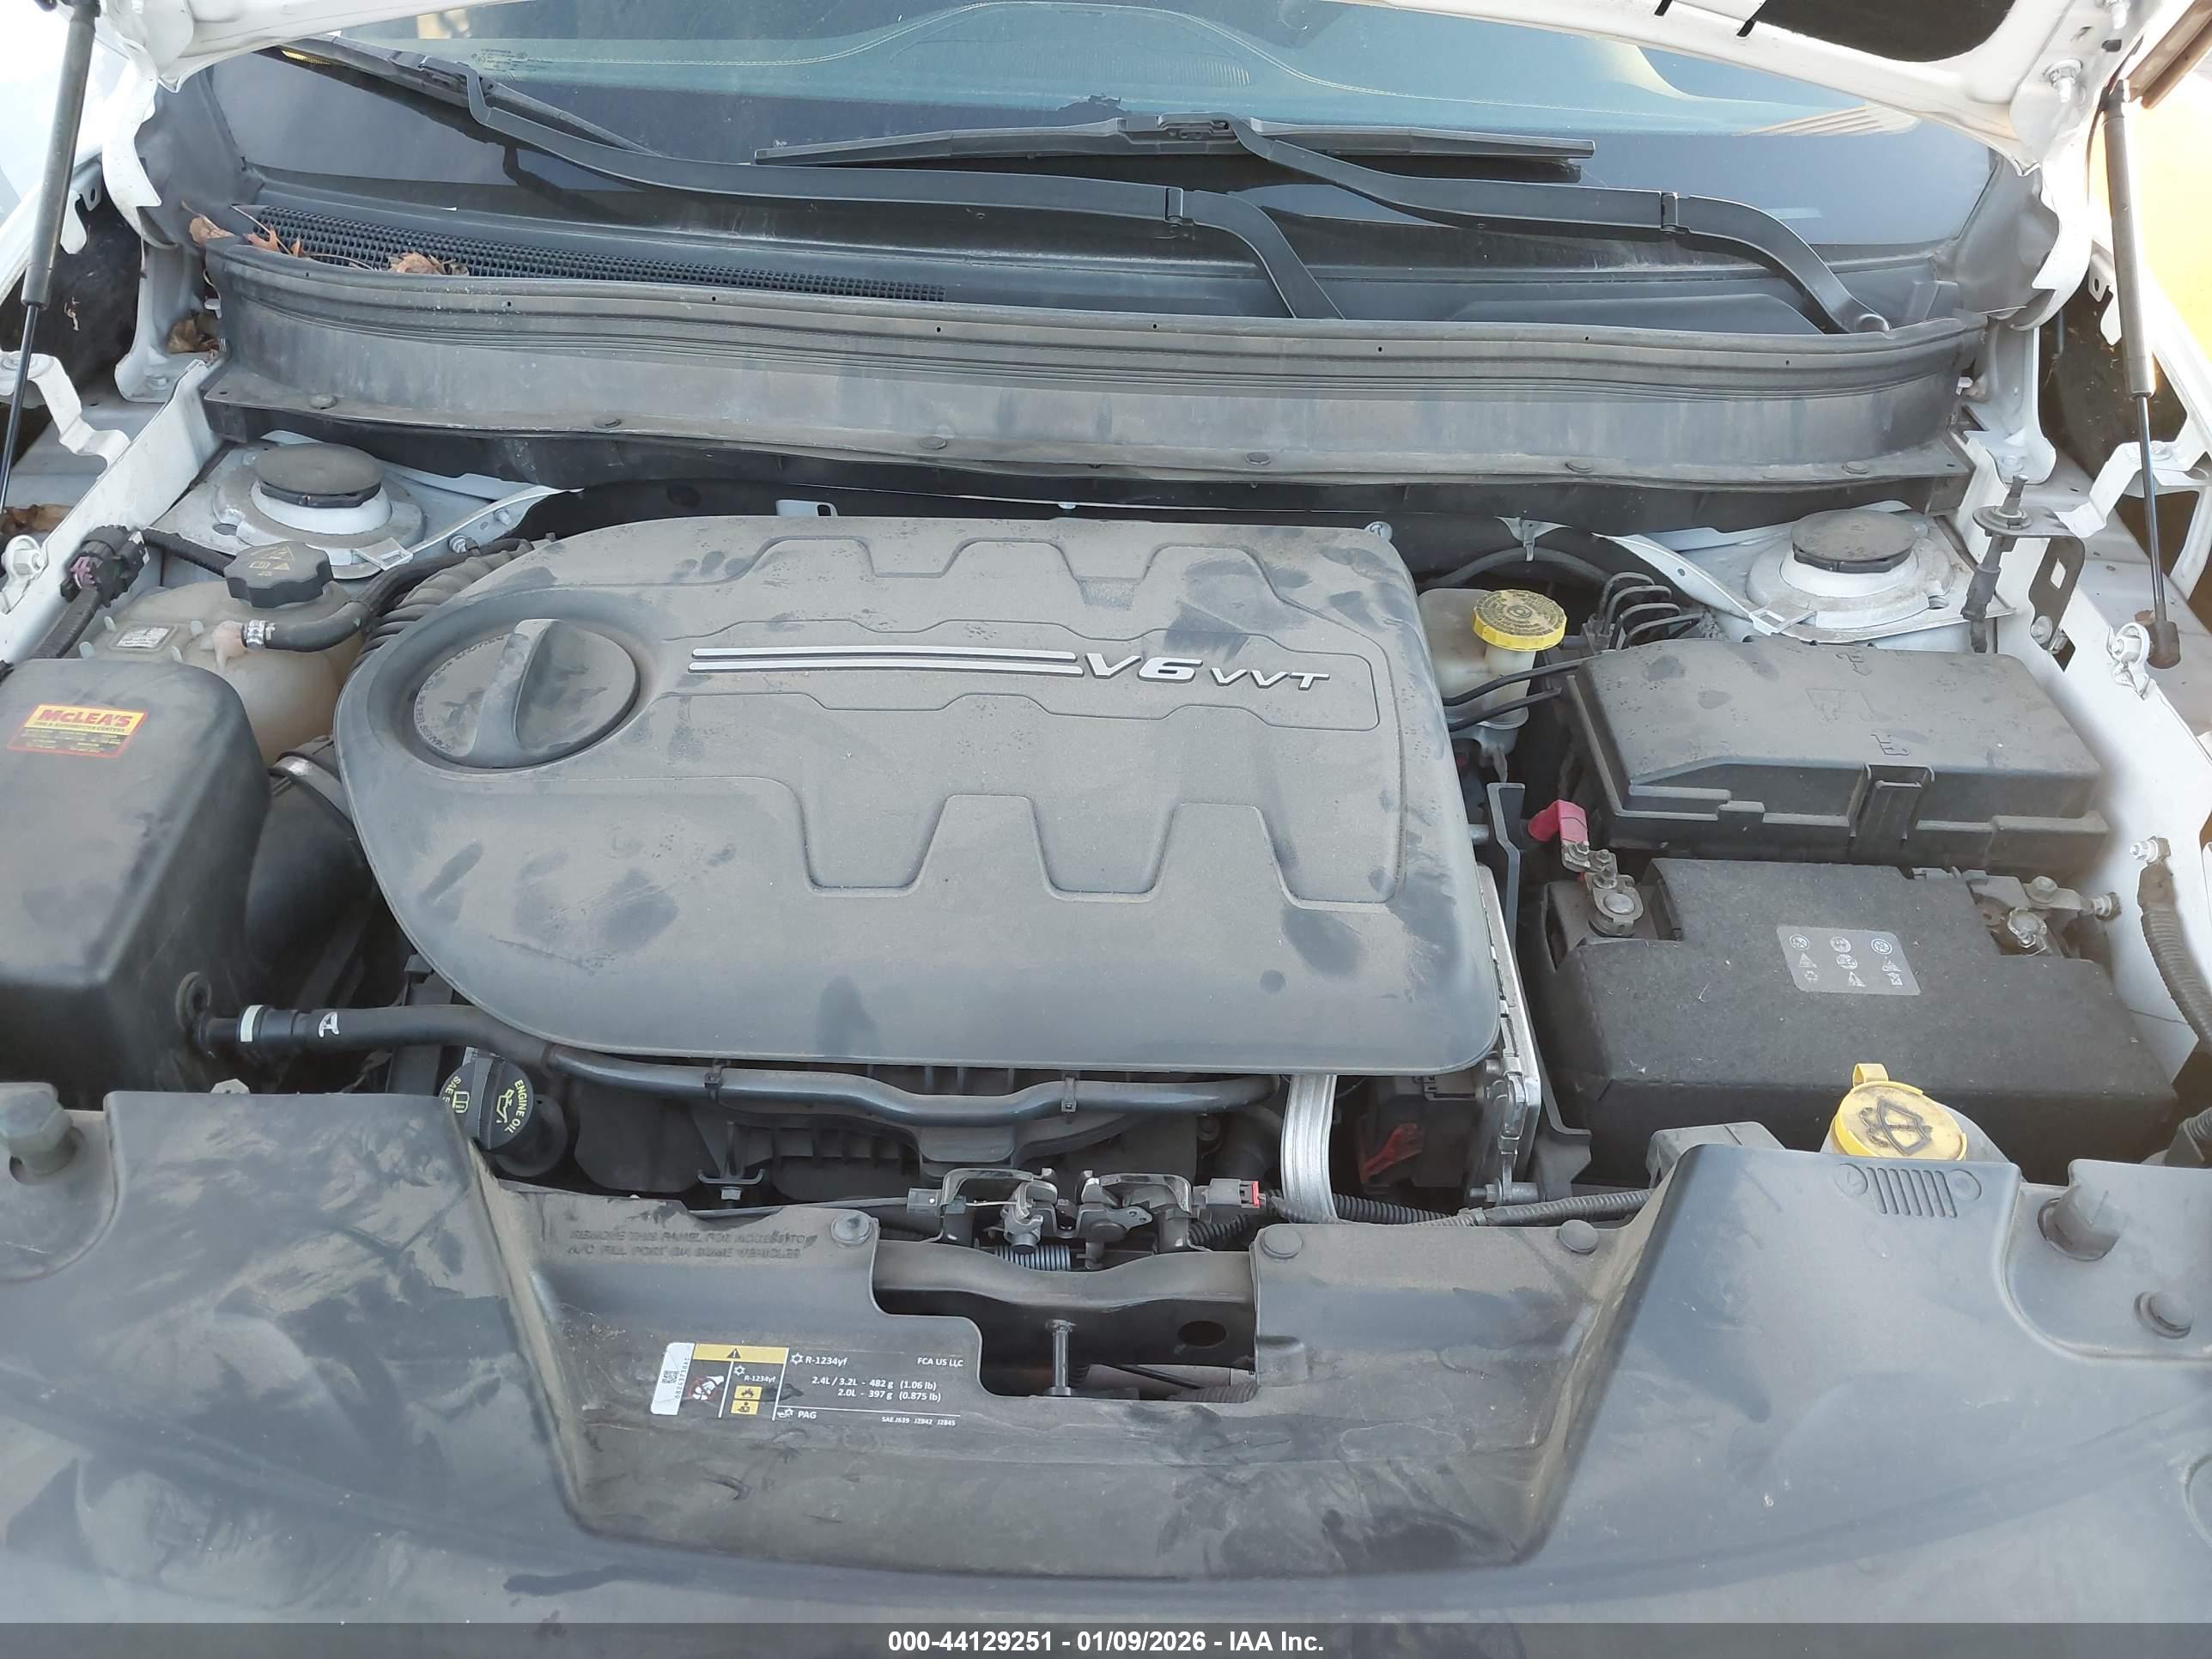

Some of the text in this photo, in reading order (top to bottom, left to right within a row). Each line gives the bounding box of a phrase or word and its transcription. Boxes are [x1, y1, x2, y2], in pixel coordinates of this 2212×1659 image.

[1086, 653, 1330, 690] V6 VVT
[319, 1012, 340, 1037] A
[445, 1076, 461, 1095] SAE
[504, 1079, 527, 1133] ENGINE OIL
[805, 1356, 848, 1368] R-1234yf
[744, 1375, 777, 1383] R-1234yf
[811, 1376, 831, 1385] 2.4L
[831, 1376, 838, 1386] /
[838, 1377, 858, 1386] 3.2L
[869, 1379, 887, 1388] 482
[888, 1381, 894, 1389] g
[900, 1380, 923, 1389] (1.06
[924, 1381, 937, 1391] lb)
[868, 1389, 885, 1398] 397
[886, 1392, 893, 1401] g
[898, 1391, 927, 1401] (0.875
[928, 1392, 941, 1402] lb)
[798, 1410, 817, 1419] PAG
